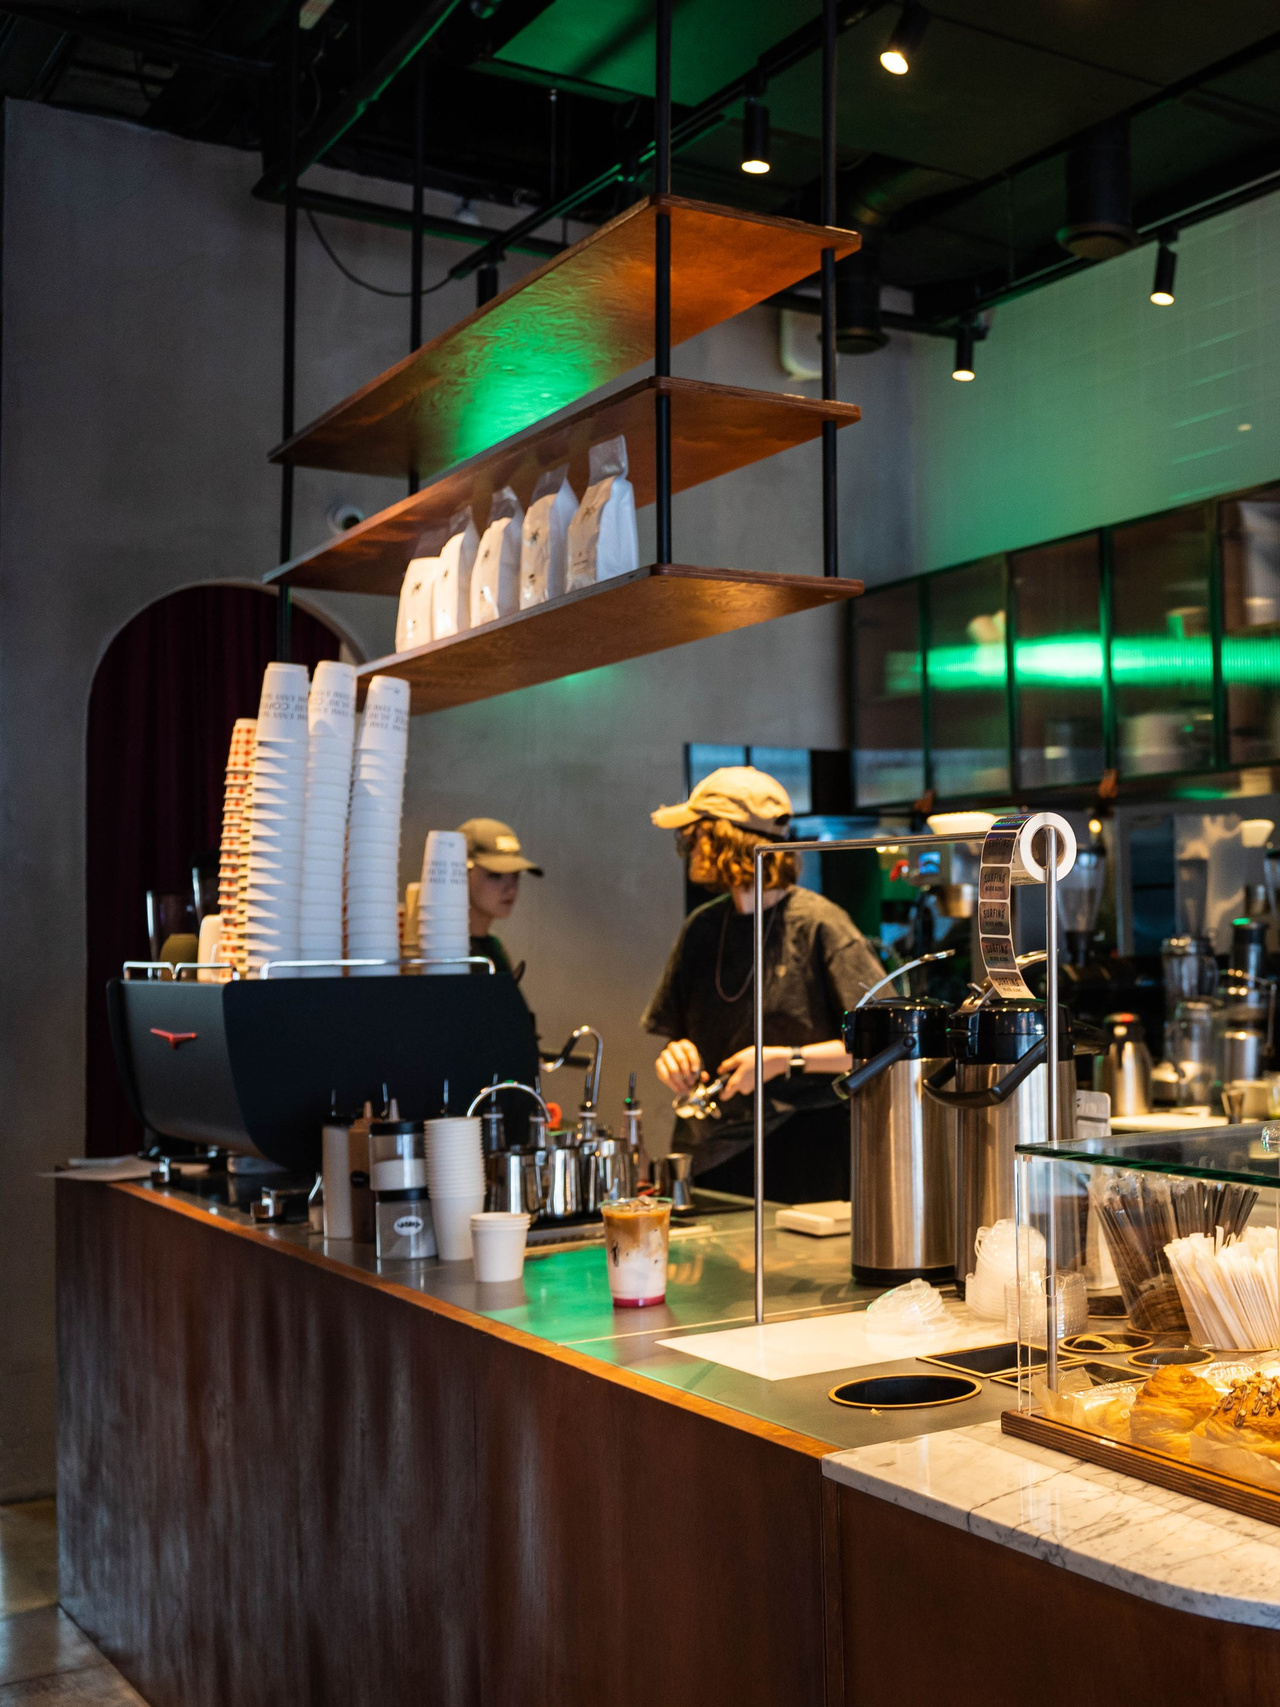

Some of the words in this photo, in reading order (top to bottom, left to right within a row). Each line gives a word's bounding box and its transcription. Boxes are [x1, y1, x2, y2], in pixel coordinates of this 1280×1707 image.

[984, 872, 1006, 883] SURFING
[983, 908, 1005, 919] SURFING
[986, 943, 1009, 954] SURFING
[1212, 1367, 1237, 1378] TRIP
[1238, 1366, 1253, 1375] TO
